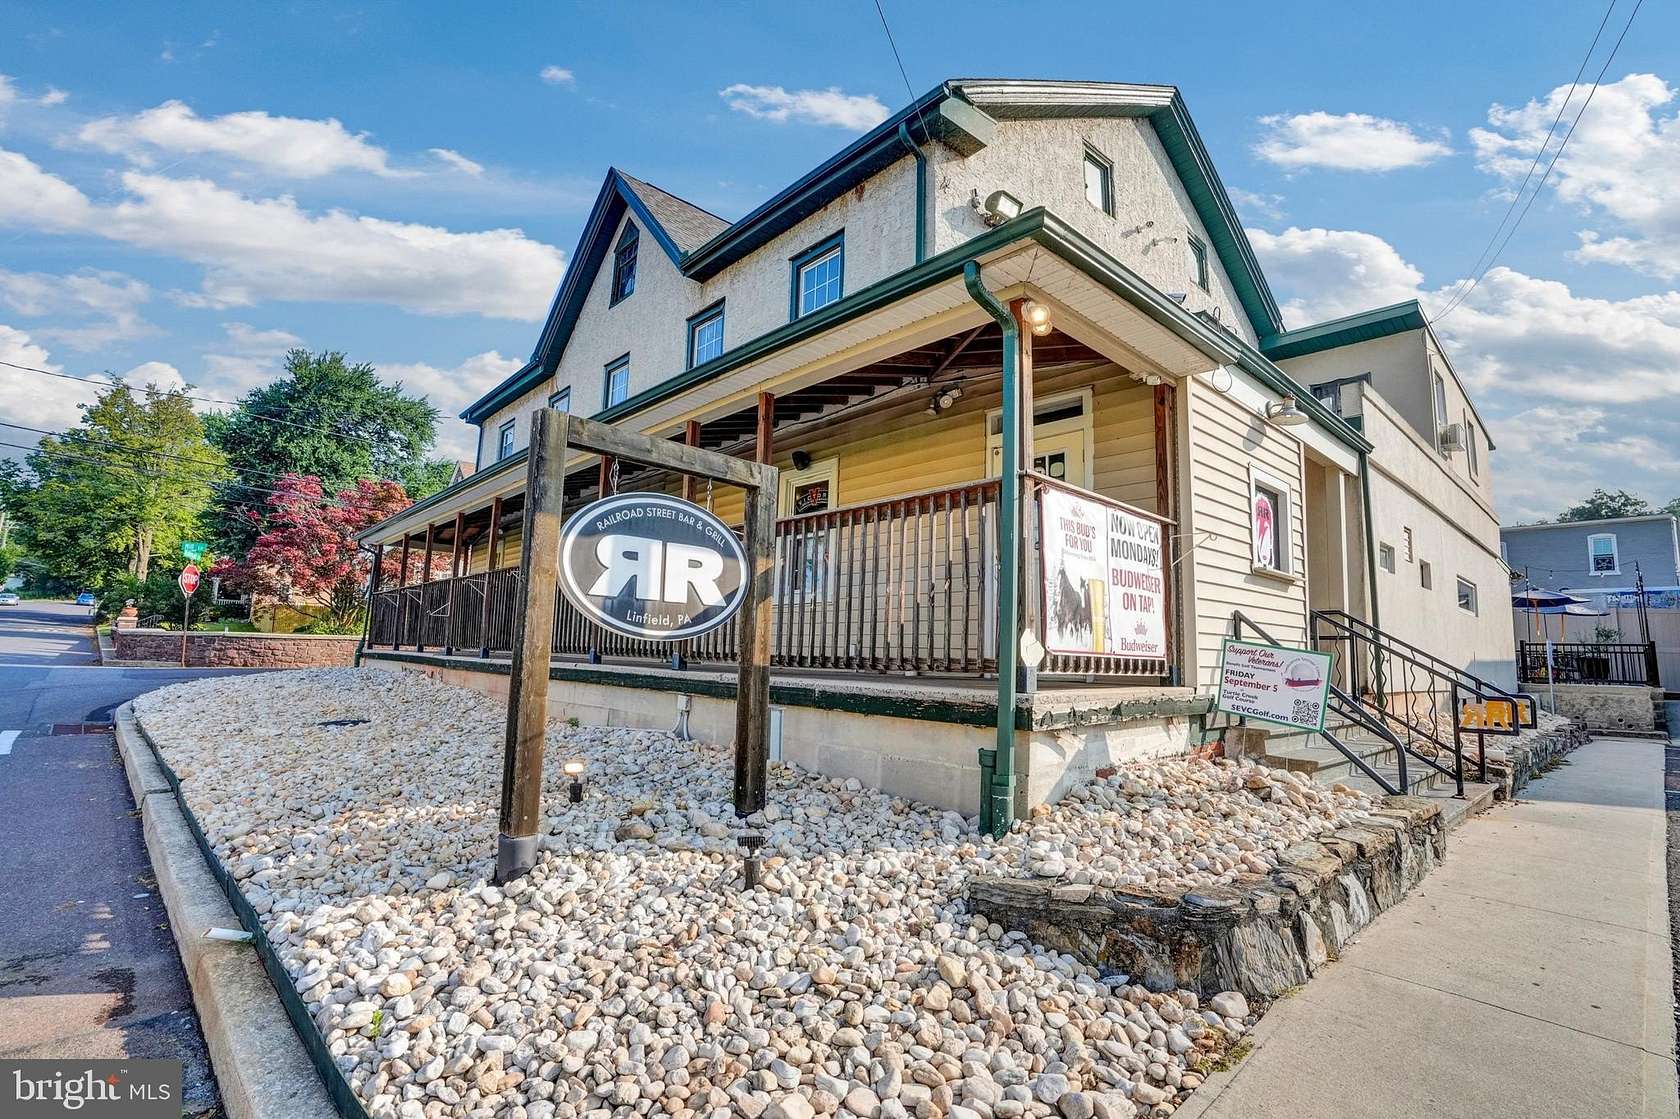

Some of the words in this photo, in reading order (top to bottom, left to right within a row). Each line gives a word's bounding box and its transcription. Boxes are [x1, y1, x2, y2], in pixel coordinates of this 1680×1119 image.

[597, 508, 643, 531] RAILROAD
[647, 508, 676, 521] STREET
[678, 512, 696, 526] BAR
[696, 520, 703, 530] &
[705, 527, 726, 548] GRILL
[1059, 517, 1075, 534] THIS
[1077, 522, 1096, 539] BUD'S
[1111, 513, 1136, 538] NOW
[1137, 521, 1159, 545] OPEN
[1065, 535, 1078, 550] FOR
[1079, 537, 1093, 553] YOU
[1111, 538, 1159, 567] MONDAYS!
[183, 573, 198, 583] STOP
[1112, 568, 1161, 594] BUDWEISER
[1122, 592, 1137, 611] ON
[1138, 594, 1155, 614] TAP!
[626, 610, 673, 627] Linfield,
[678, 614, 692, 624] PA
[1121, 637, 1158, 653] Budweiser
[1227, 645, 1257, 656] Support
[1259, 650, 1274, 658] Our
[1248, 656, 1284, 668] Veterans!
[1225, 669, 1255, 679] FRIDAY
[1224, 676, 1271, 691] September
[1231, 704, 1289, 721] SEVCGolf.com
